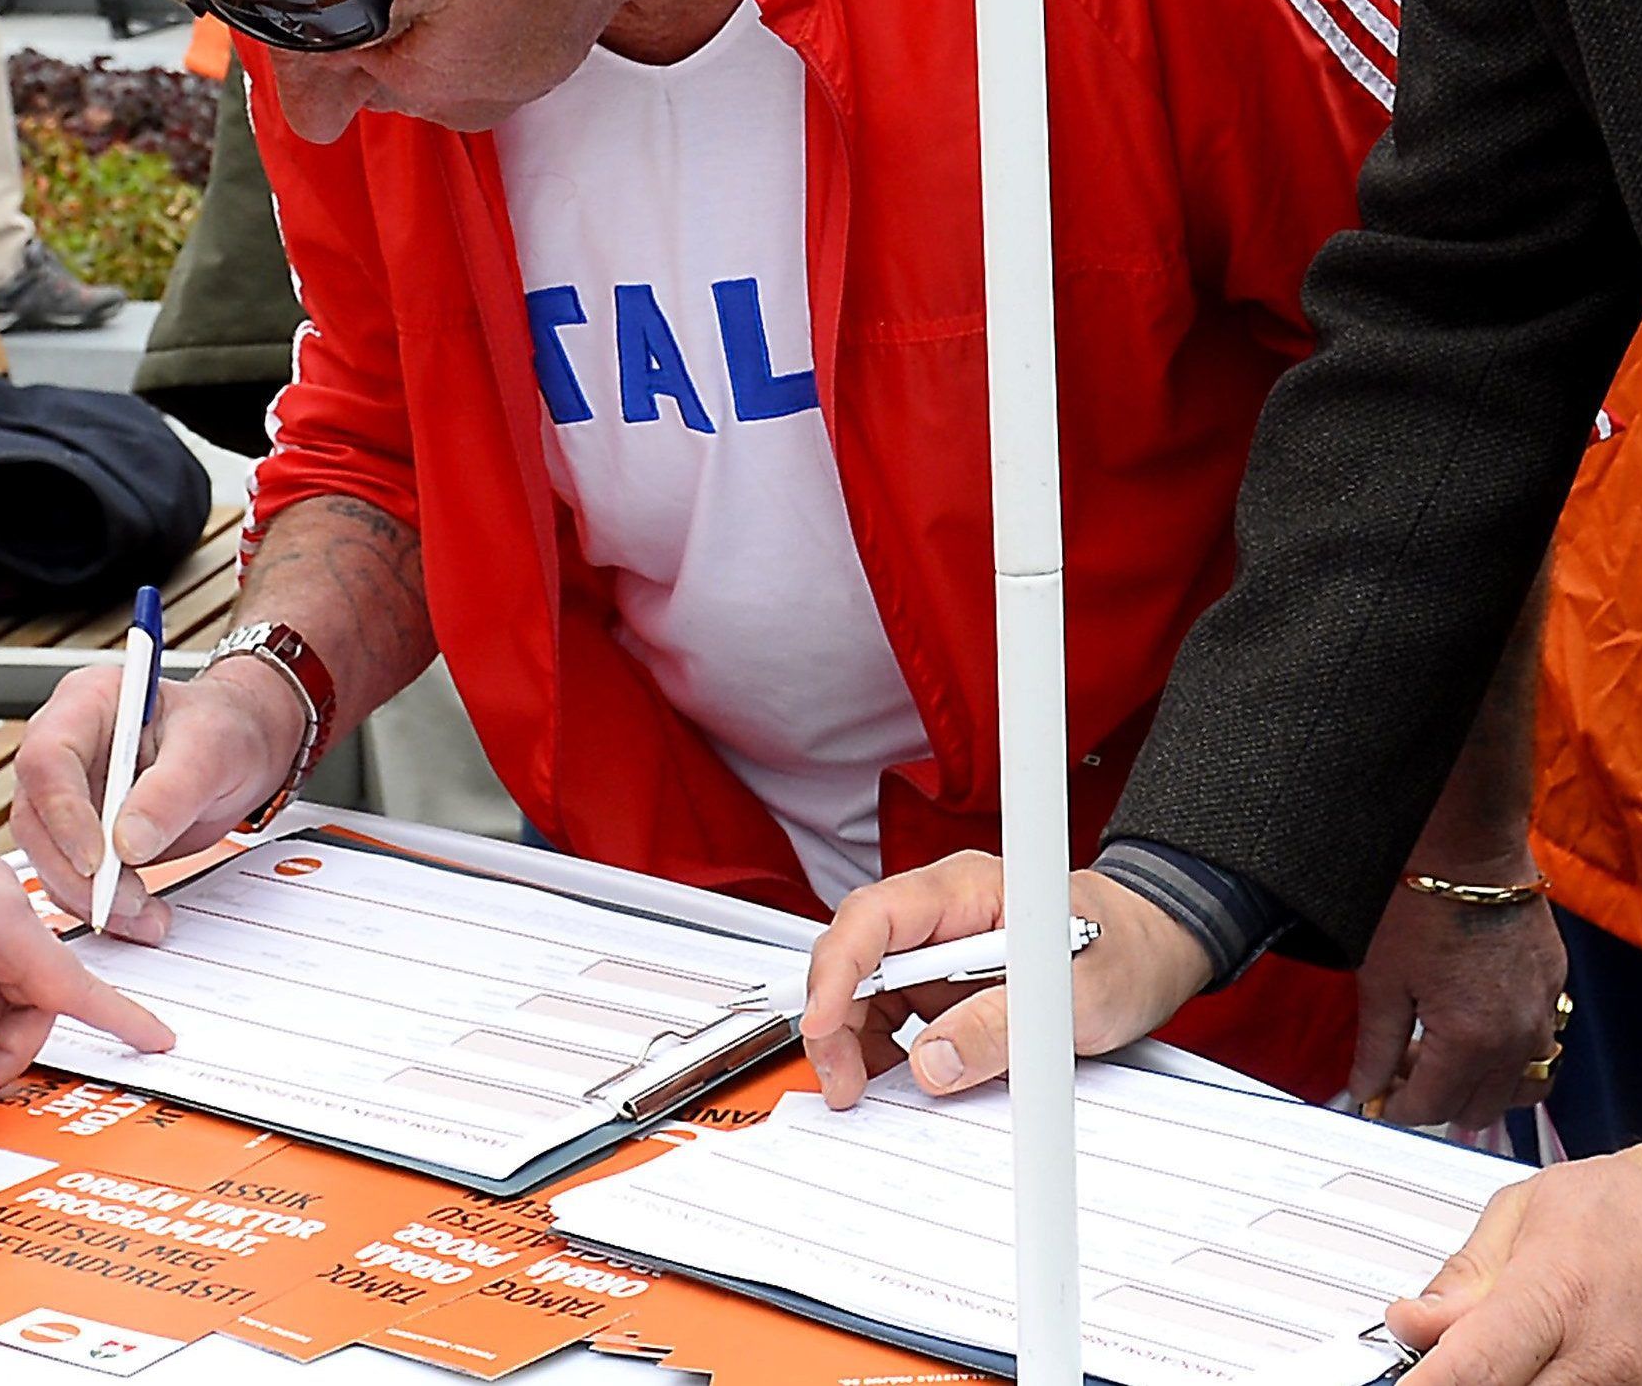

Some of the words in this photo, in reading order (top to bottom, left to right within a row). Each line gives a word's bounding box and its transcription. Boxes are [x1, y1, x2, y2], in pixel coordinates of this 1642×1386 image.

[525, 277, 821, 434] TAL
[57, 1171, 191, 1212] ORBÁN
[184, 1199, 326, 1241] VIKTOR
[207, 1179, 324, 1211] ASSUK
[137, 1245, 227, 1273] MEG
[392, 1222, 520, 1268] PROGR
[478, 1278, 606, 1320] TÁMOG
